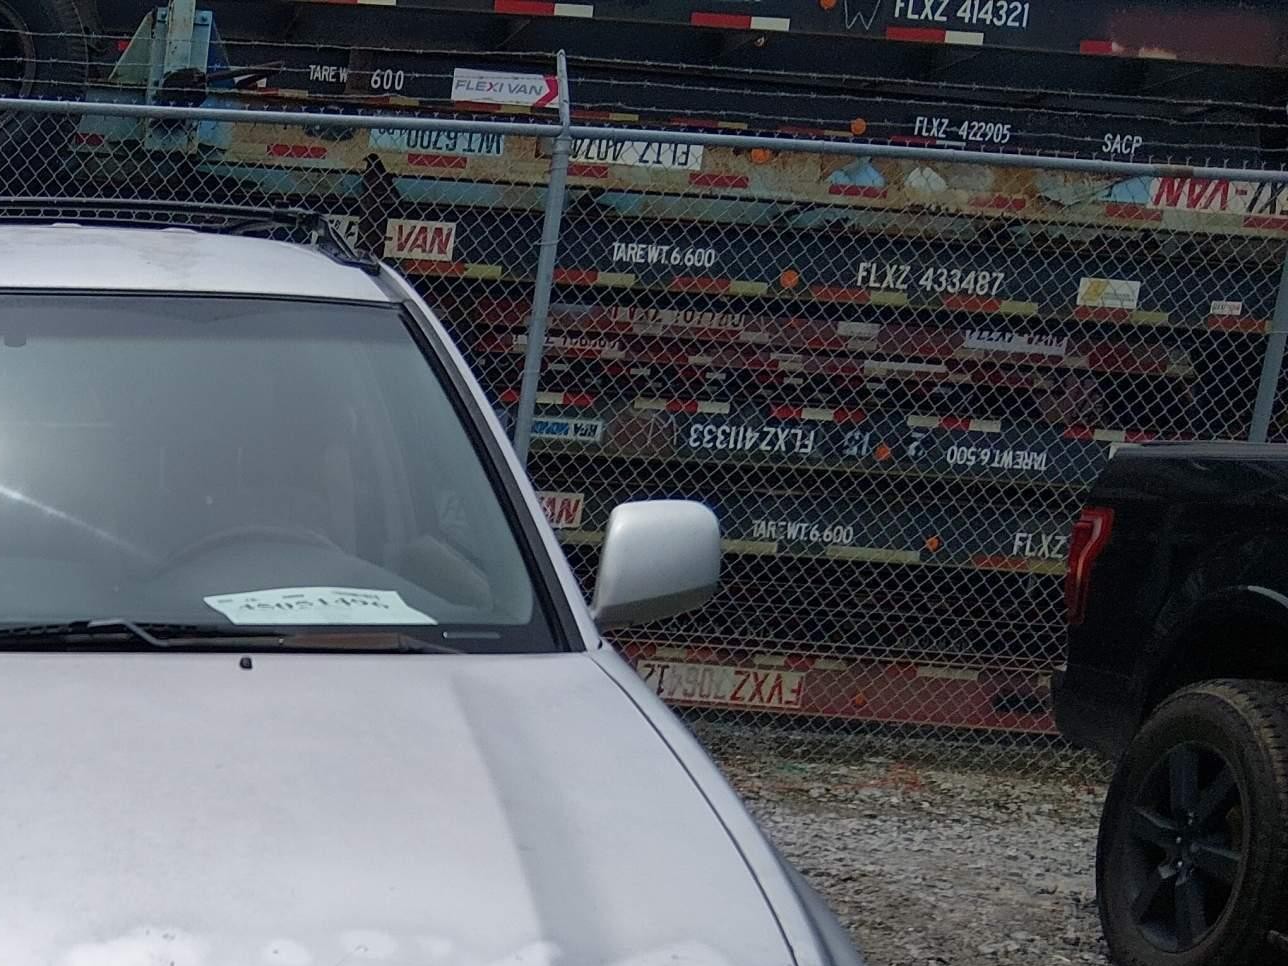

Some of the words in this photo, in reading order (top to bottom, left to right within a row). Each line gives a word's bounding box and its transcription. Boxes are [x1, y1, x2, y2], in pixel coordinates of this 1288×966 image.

[894, 0, 948, 21] FLXZ
[956, 0, 1030, 28] 414321
[309, 65, 337, 82] TARE
[454, 79, 505, 93] FLEXI
[508, 82, 544, 96] VAN
[914, 117, 949, 137] FLXZ
[959, 121, 1011, 143] 422905
[856, 262, 910, 289] FLXZ
[918, 267, 1005, 296] 433487
[689, 423, 760, 450] 411333
[762, 426, 814, 454] FLXZ
[1013, 532, 1067, 560] FLXZ
[730, 669, 805, 705] FVXZ
